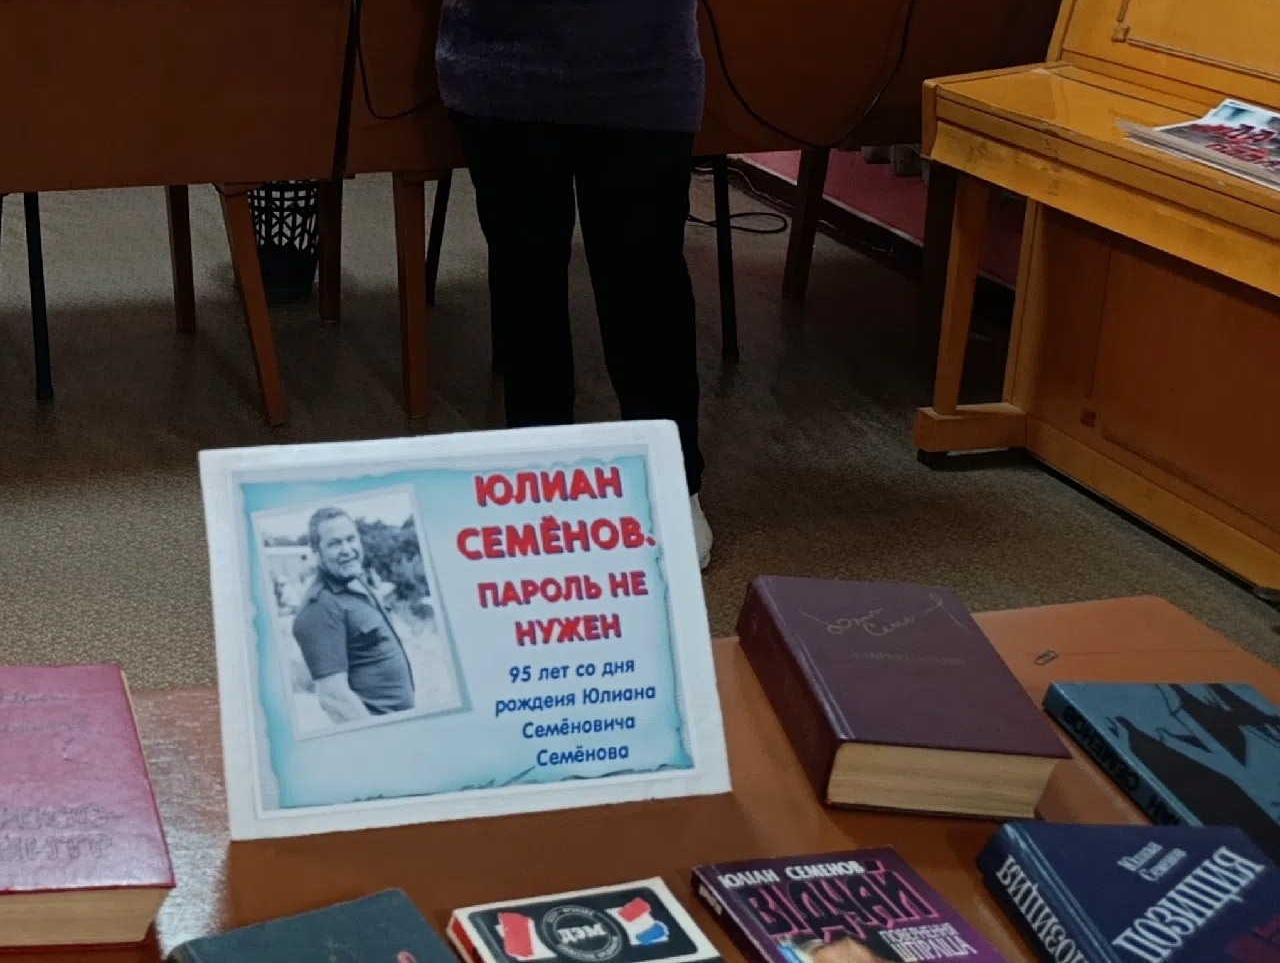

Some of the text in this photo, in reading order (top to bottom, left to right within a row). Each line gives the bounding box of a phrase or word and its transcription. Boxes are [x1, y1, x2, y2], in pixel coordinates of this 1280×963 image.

[474, 466, 623, 508] ЮЛИАН
[456, 515, 657, 562] СЕМЁНОВ.
[477, 570, 649, 610] ПАРОЛЬ НЕ
[514, 613, 622, 647] НУЖЕН
[508, 659, 635, 684] 95 лет со дня
[582, 685, 657, 705] Юлиана
[522, 715, 635, 739] Семёновича
[536, 744, 630, 767] Семёнова
[784, 860, 865, 881] СЕМЕНОВ
[1111, 845, 1267, 962] ПОЗИЦИЯ
